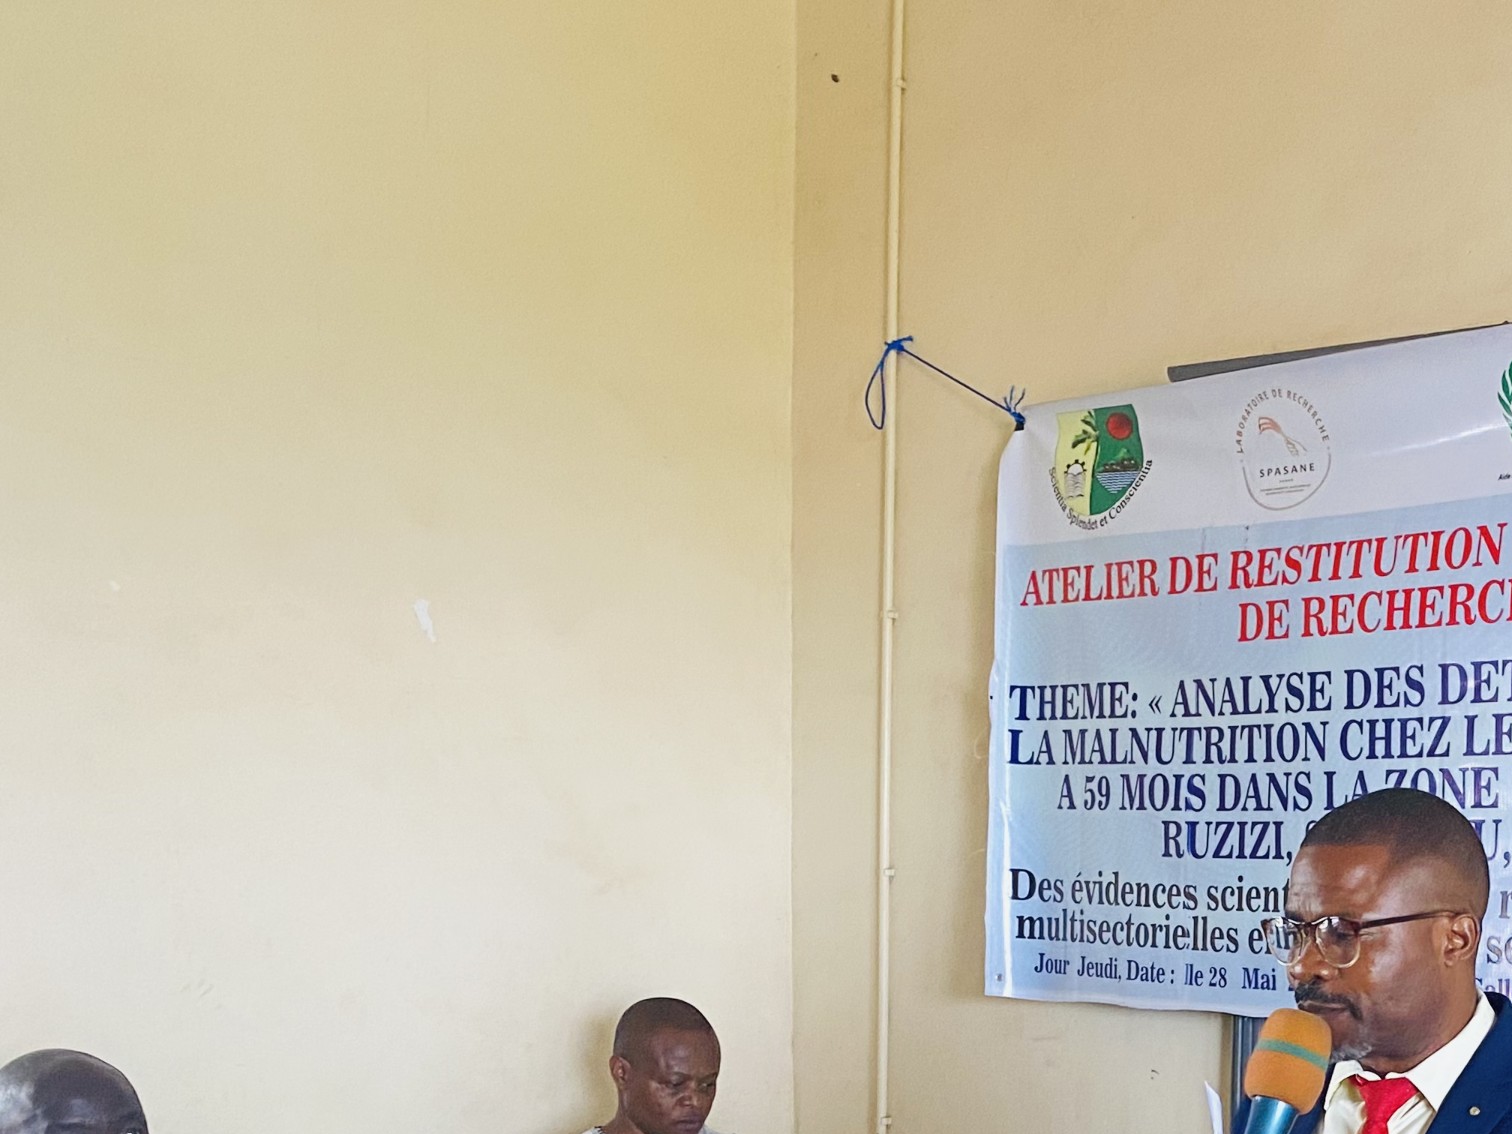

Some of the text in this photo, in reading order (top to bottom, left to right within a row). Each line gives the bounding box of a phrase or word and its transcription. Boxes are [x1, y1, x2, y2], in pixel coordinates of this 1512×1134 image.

[1235, 388, 1330, 454] LABORATOIRE DE RECHERCHE
[1259, 462, 1316, 478] SPASANE
[1048, 459, 1153, 531] Scientia Splendet et Conscientia
[1020, 559, 1159, 606] ATELIER
[1168, 553, 1219, 595] DE
[1229, 522, 1508, 590] RESTITUTION
[1237, 599, 1290, 642] DE
[1009, 681, 1138, 721] THEME:
[1169, 670, 1332, 718] ANALYSE
[1344, 664, 1425, 710] DES
[1008, 729, 1054, 766] LA
[1062, 721, 1327, 766] MALNUTRITION
[1340, 715, 1452, 761] CHEZ
[1057, 780, 1076, 811] A
[1083, 776, 1111, 811] 59
[1119, 773, 1206, 813] MOIS
[1215, 771, 1313, 813] DANS
[1161, 819, 1293, 867] RUZIZI,
[1009, 867, 1064, 904] Des
[1070, 871, 1198, 911] évidences
[1015, 908, 1239, 955] multisectorielles
[1034, 952, 1070, 975] Jour
[1077, 955, 1121, 983] Jeudi,
[1126, 959, 1166, 984] Date
[1208, 967, 1228, 988] 28
[1241, 967, 1277, 991] Mai
